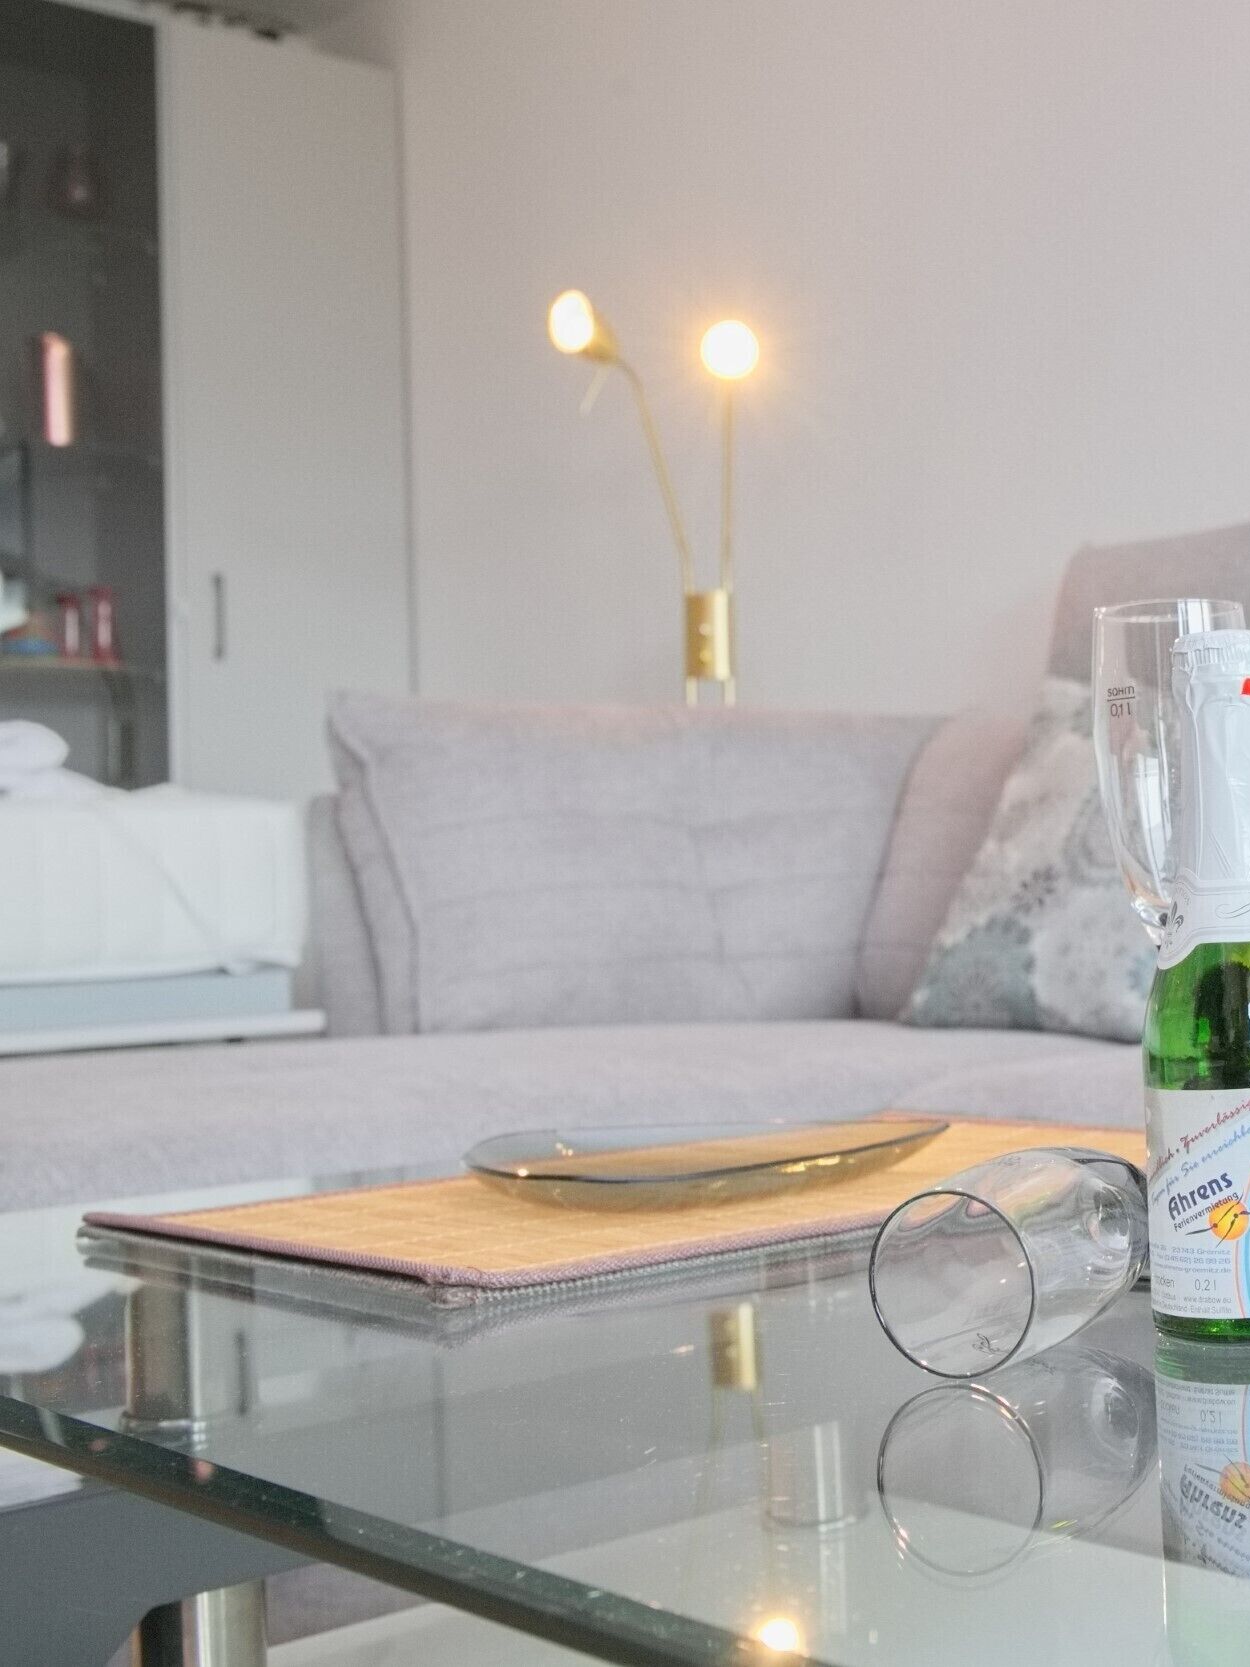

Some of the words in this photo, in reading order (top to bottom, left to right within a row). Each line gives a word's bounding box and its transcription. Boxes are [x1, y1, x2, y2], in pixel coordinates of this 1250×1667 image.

[1181, 1161, 1199, 1177] Sie
[1168, 1172, 1233, 1221] Ahrens
[1173, 1192, 1239, 1232] Ferienvermietung
